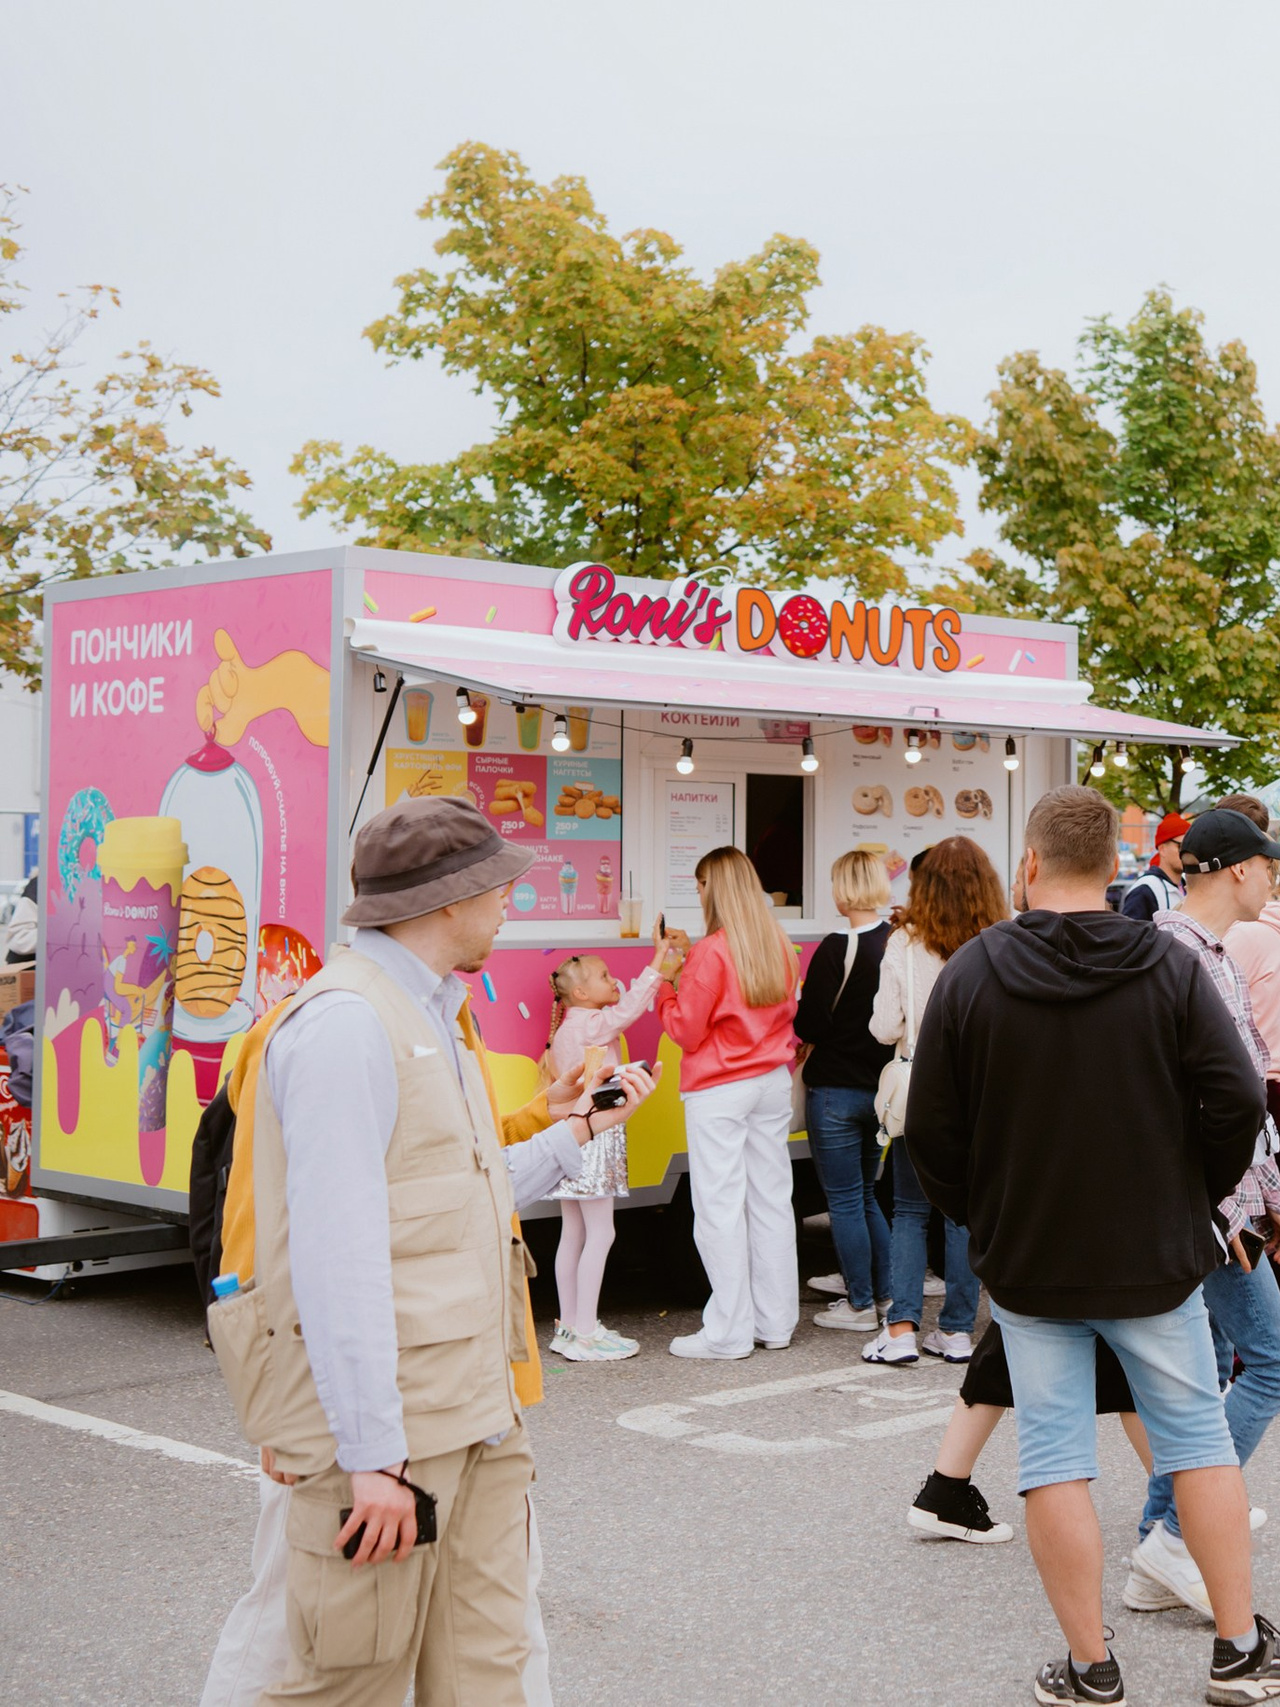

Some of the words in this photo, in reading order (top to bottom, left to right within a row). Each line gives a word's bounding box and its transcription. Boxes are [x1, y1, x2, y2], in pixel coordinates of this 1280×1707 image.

[568, 564, 731, 644] Roni's
[736, 587, 962, 673] DONUTS
[70, 618, 193, 665] ПОНЧИКИ
[70, 682, 87, 718] И
[92, 676, 165, 717] КОФЕ
[474, 756, 509, 765] СЫРНЫЕ
[474, 765, 514, 774] ПАЛОЧКИ
[670, 793, 718, 803] НАПИТКИ
[501, 820, 517, 829] 250
[280, 855, 287, 875] НА
